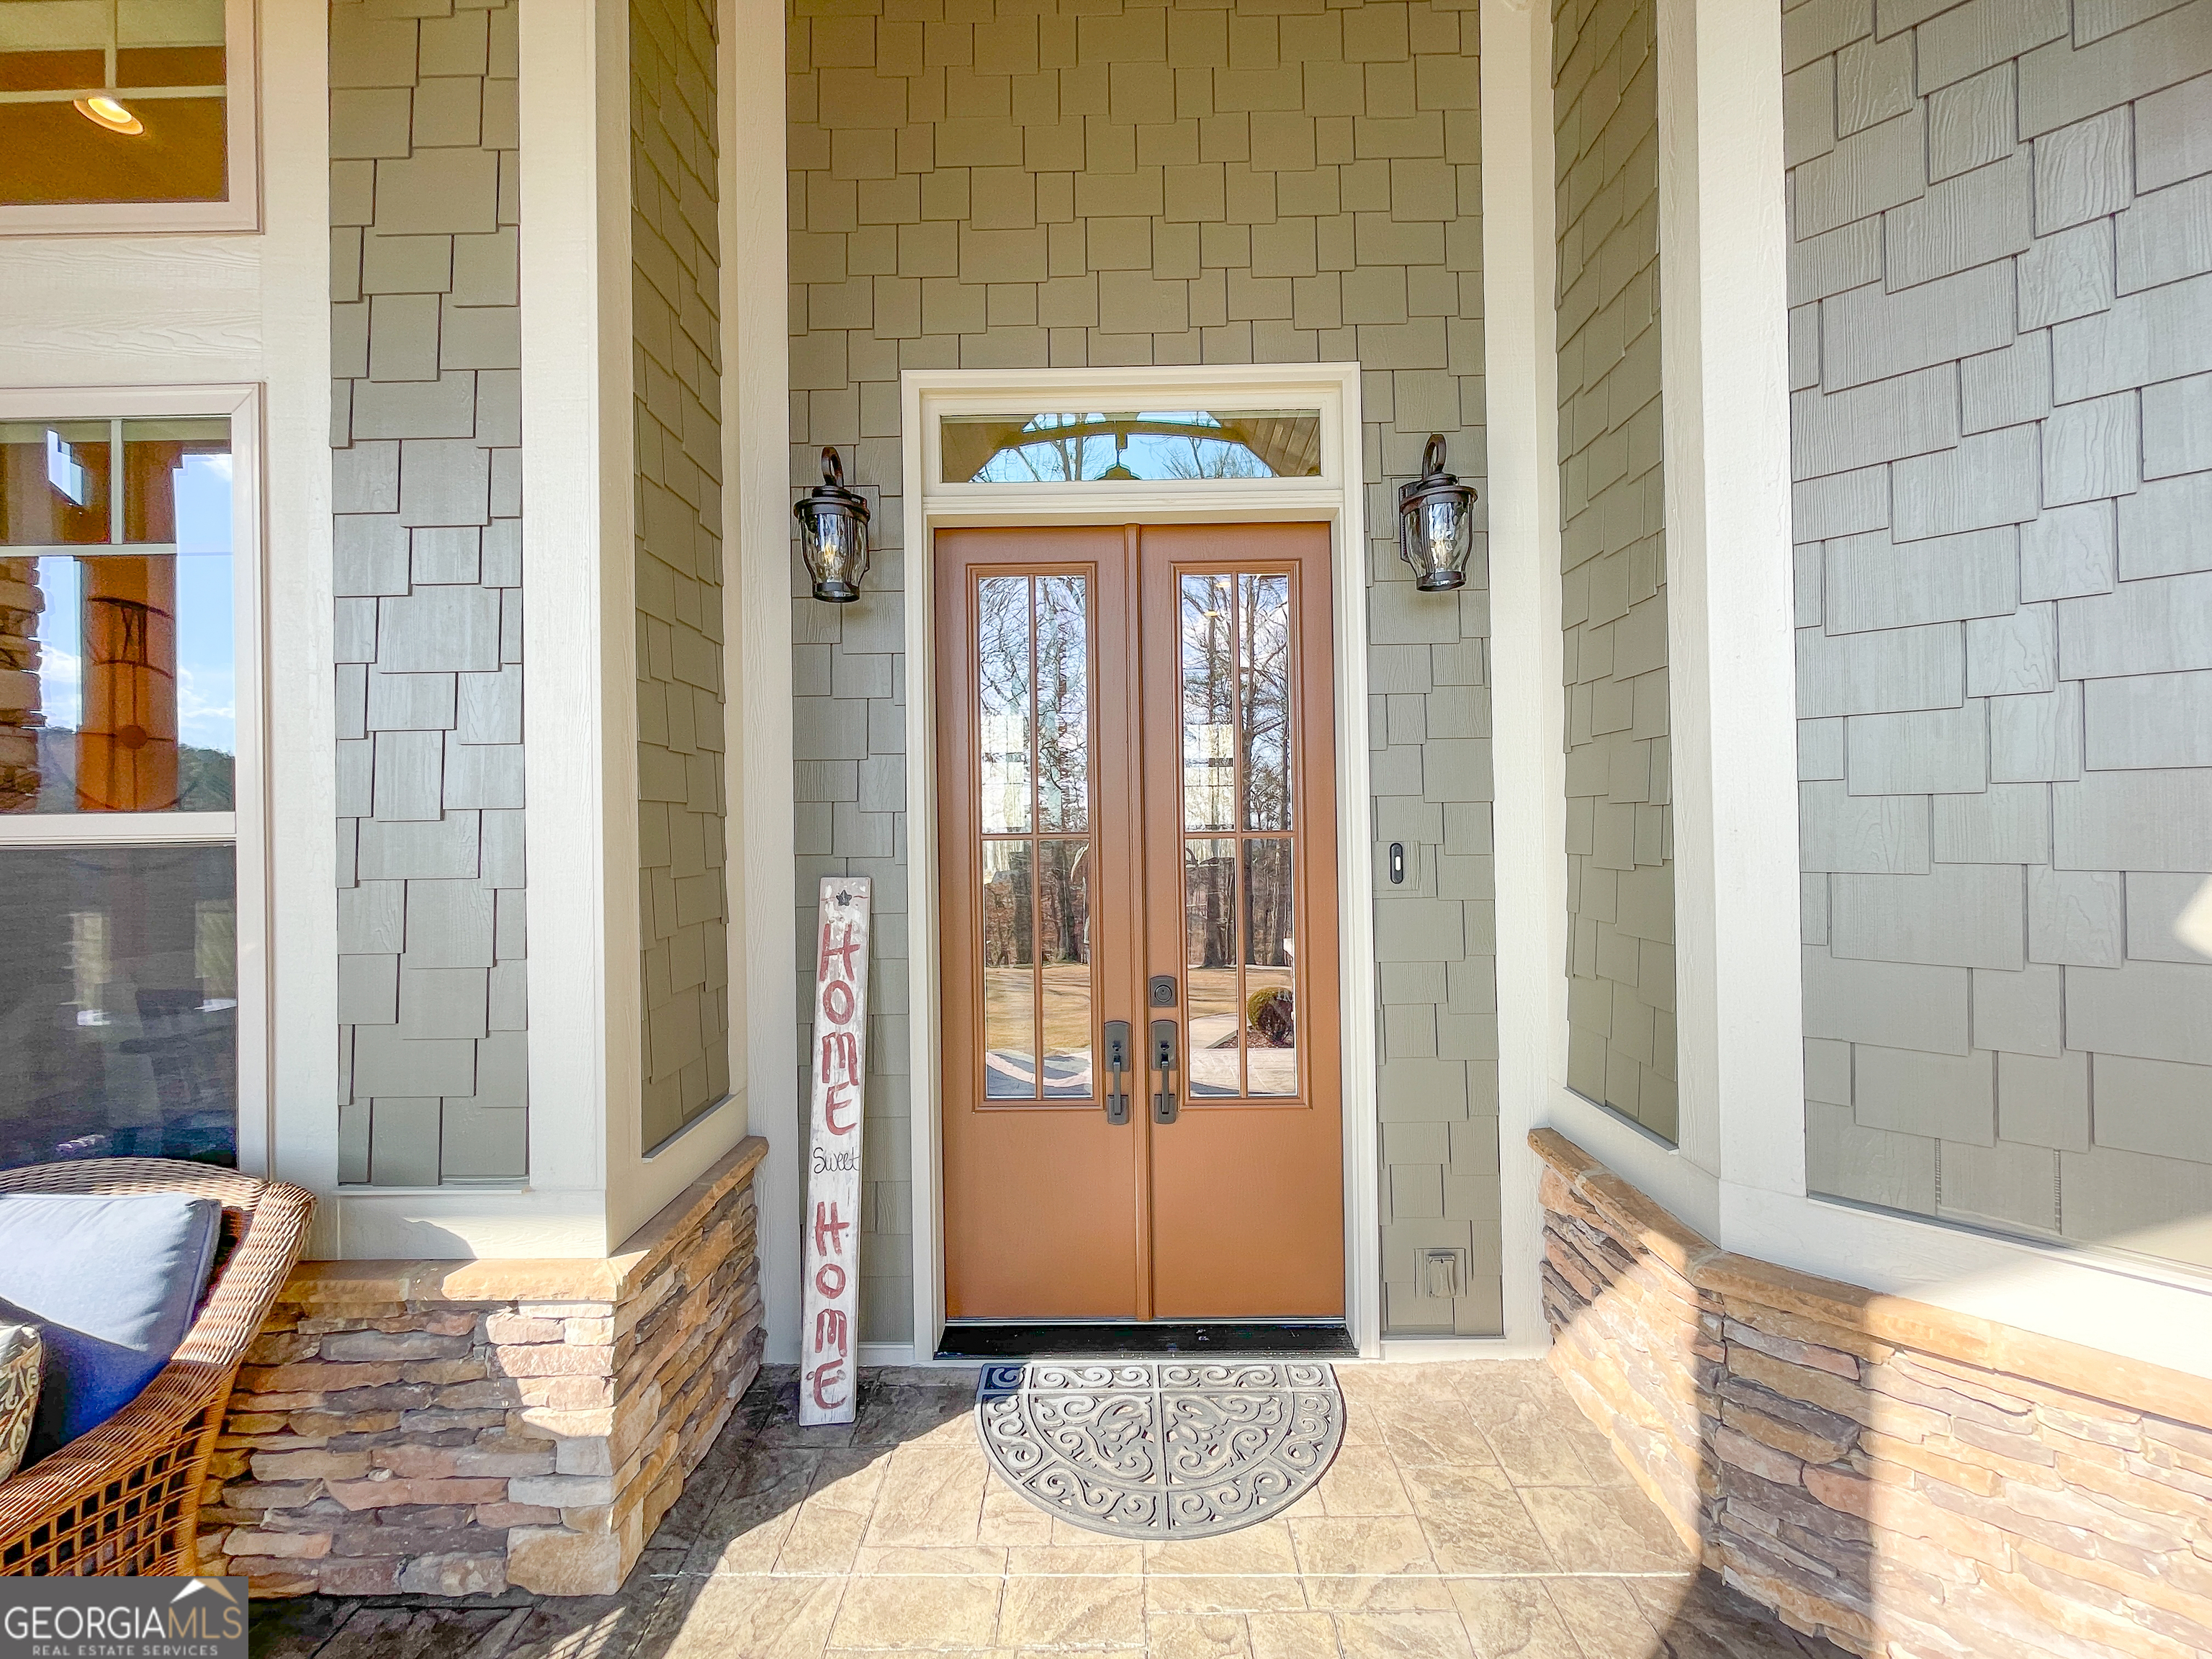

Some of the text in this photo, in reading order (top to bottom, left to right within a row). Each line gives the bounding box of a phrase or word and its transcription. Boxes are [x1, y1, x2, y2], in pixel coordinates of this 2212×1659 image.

[819, 922, 861, 1136] HOME
[813, 1146, 860, 1174] Sweet
[813, 1201, 850, 1410] HOME
